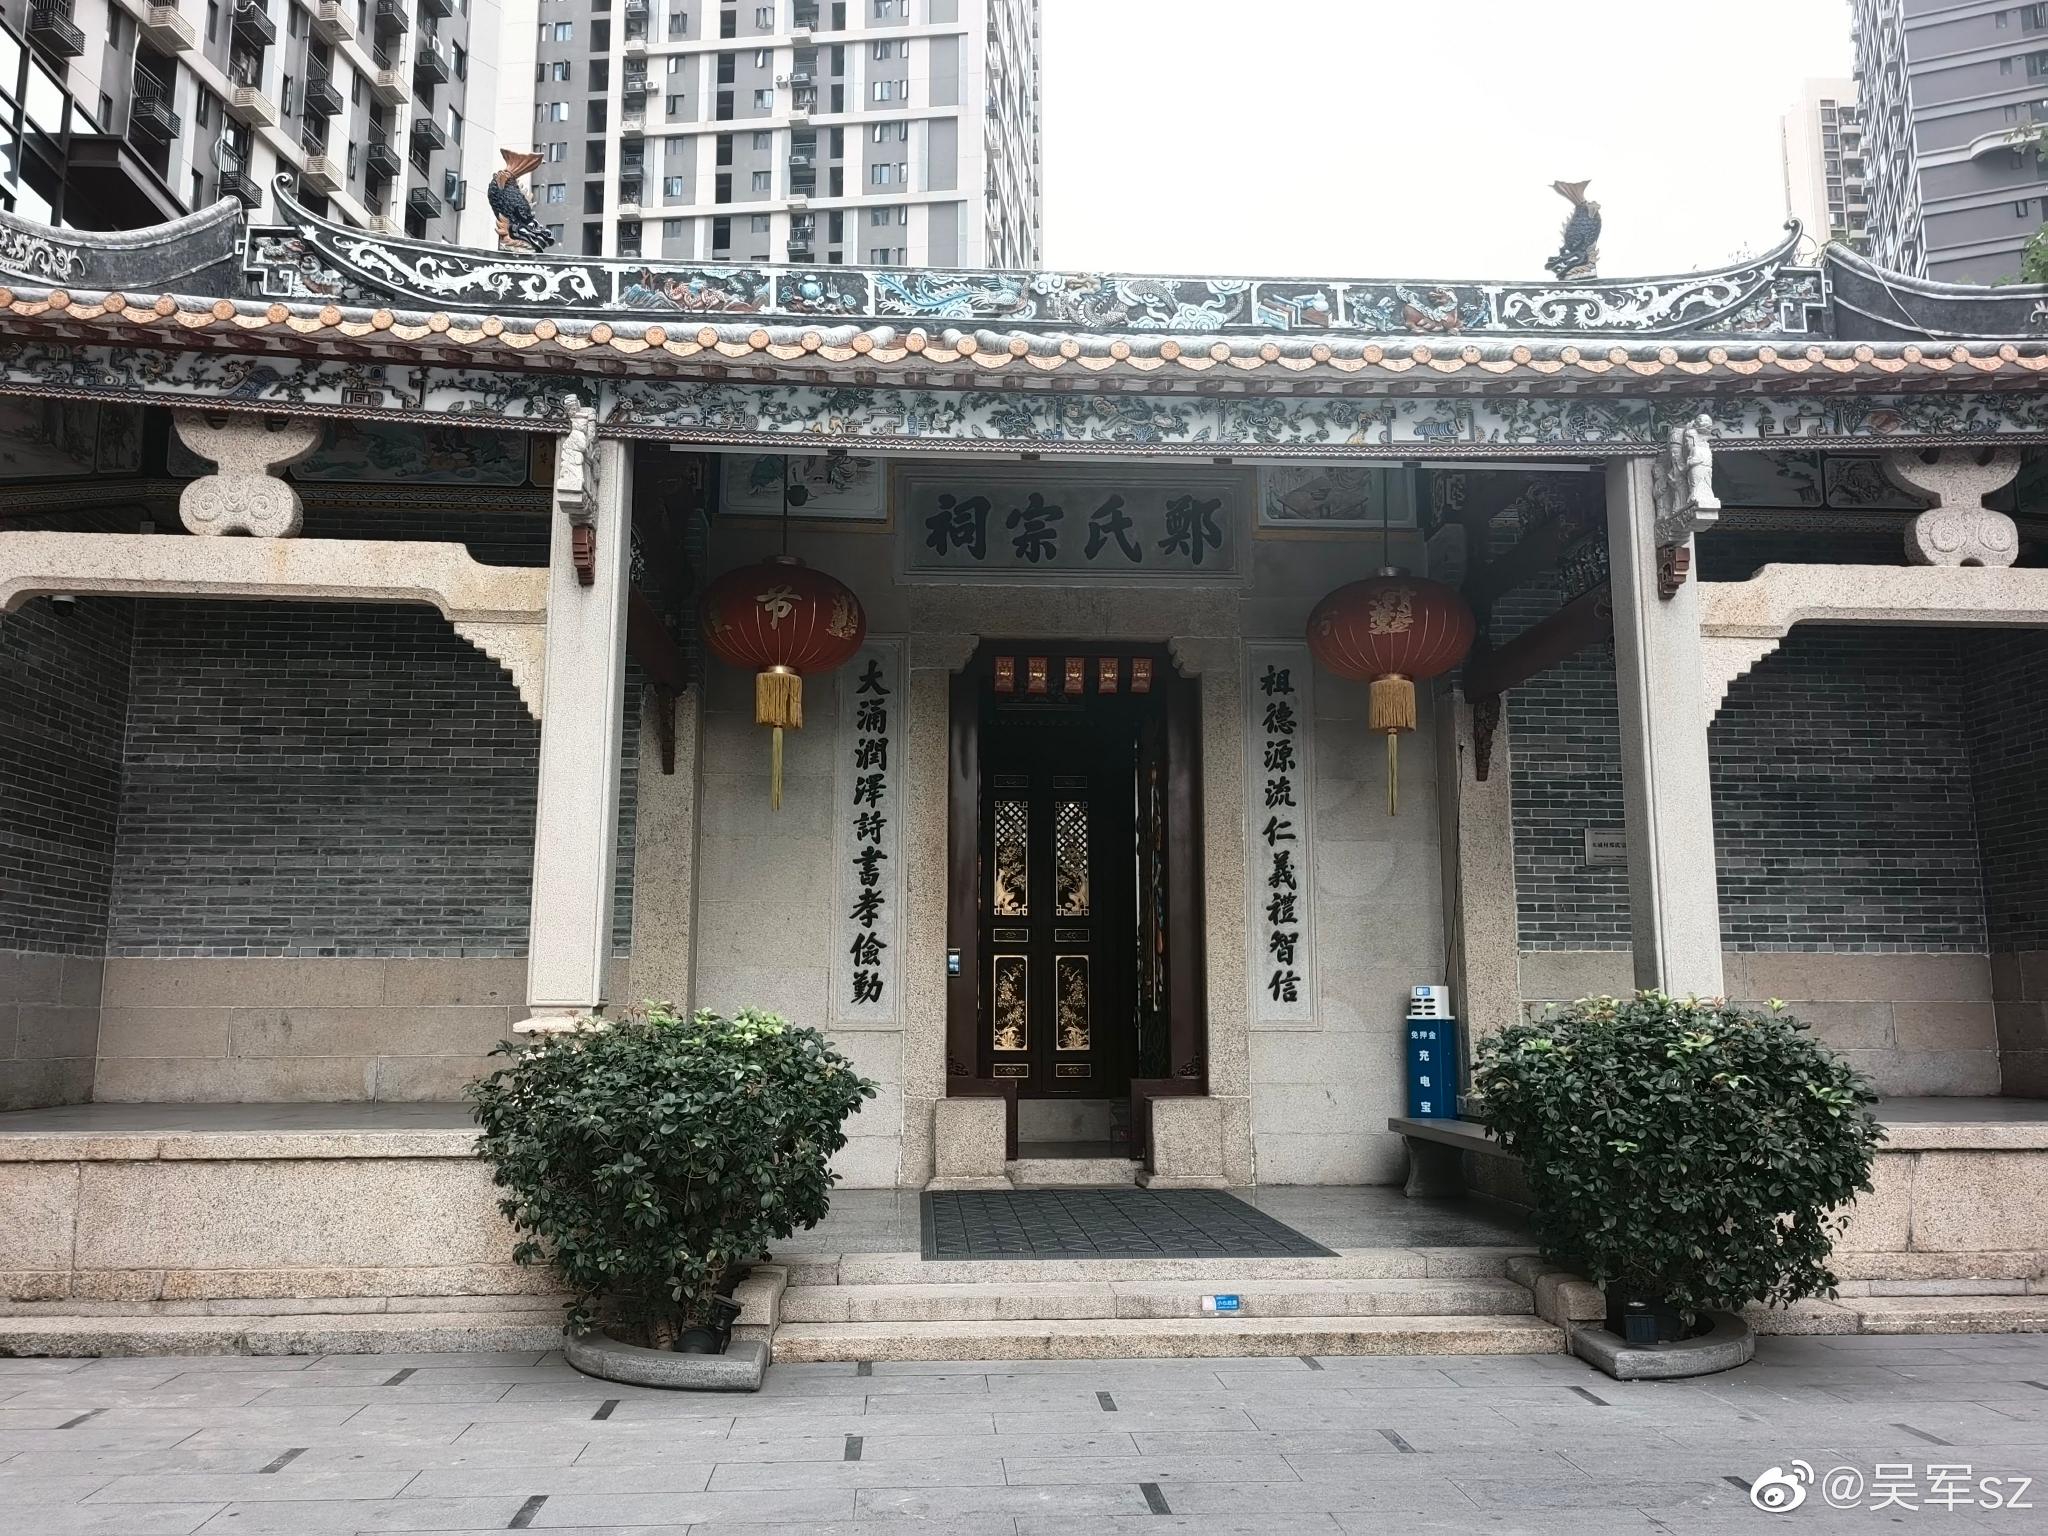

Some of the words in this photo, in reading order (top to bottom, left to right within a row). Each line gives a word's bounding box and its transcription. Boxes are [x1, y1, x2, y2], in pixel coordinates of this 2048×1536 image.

[755, 584, 802, 630] 节
[1411, 1031, 1436, 1040] 免押金
[1419, 1050, 1432, 1113] 充电宝
